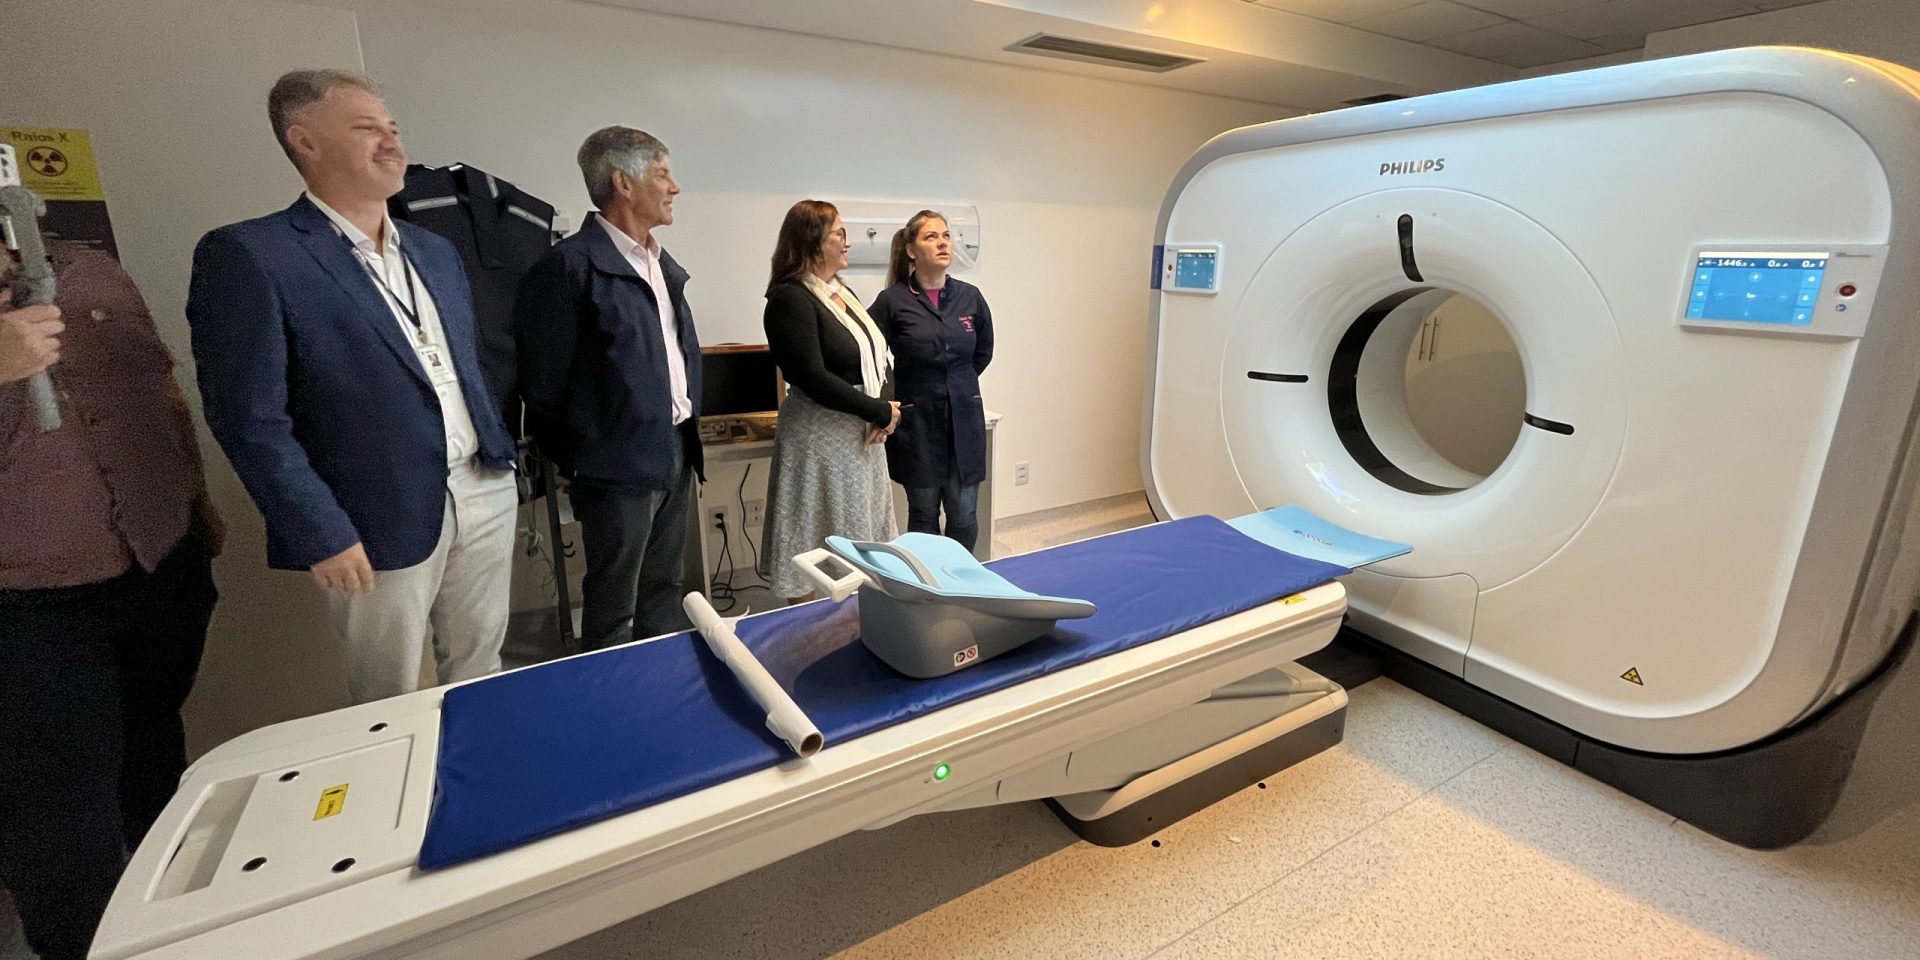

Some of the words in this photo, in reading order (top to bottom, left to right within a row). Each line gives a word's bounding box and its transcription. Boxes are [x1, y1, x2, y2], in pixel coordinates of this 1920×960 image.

[12, 131, 55, 142] Raios
[58, 132, 70, 143] X
[1379, 157, 1446, 176] PHILIPS
